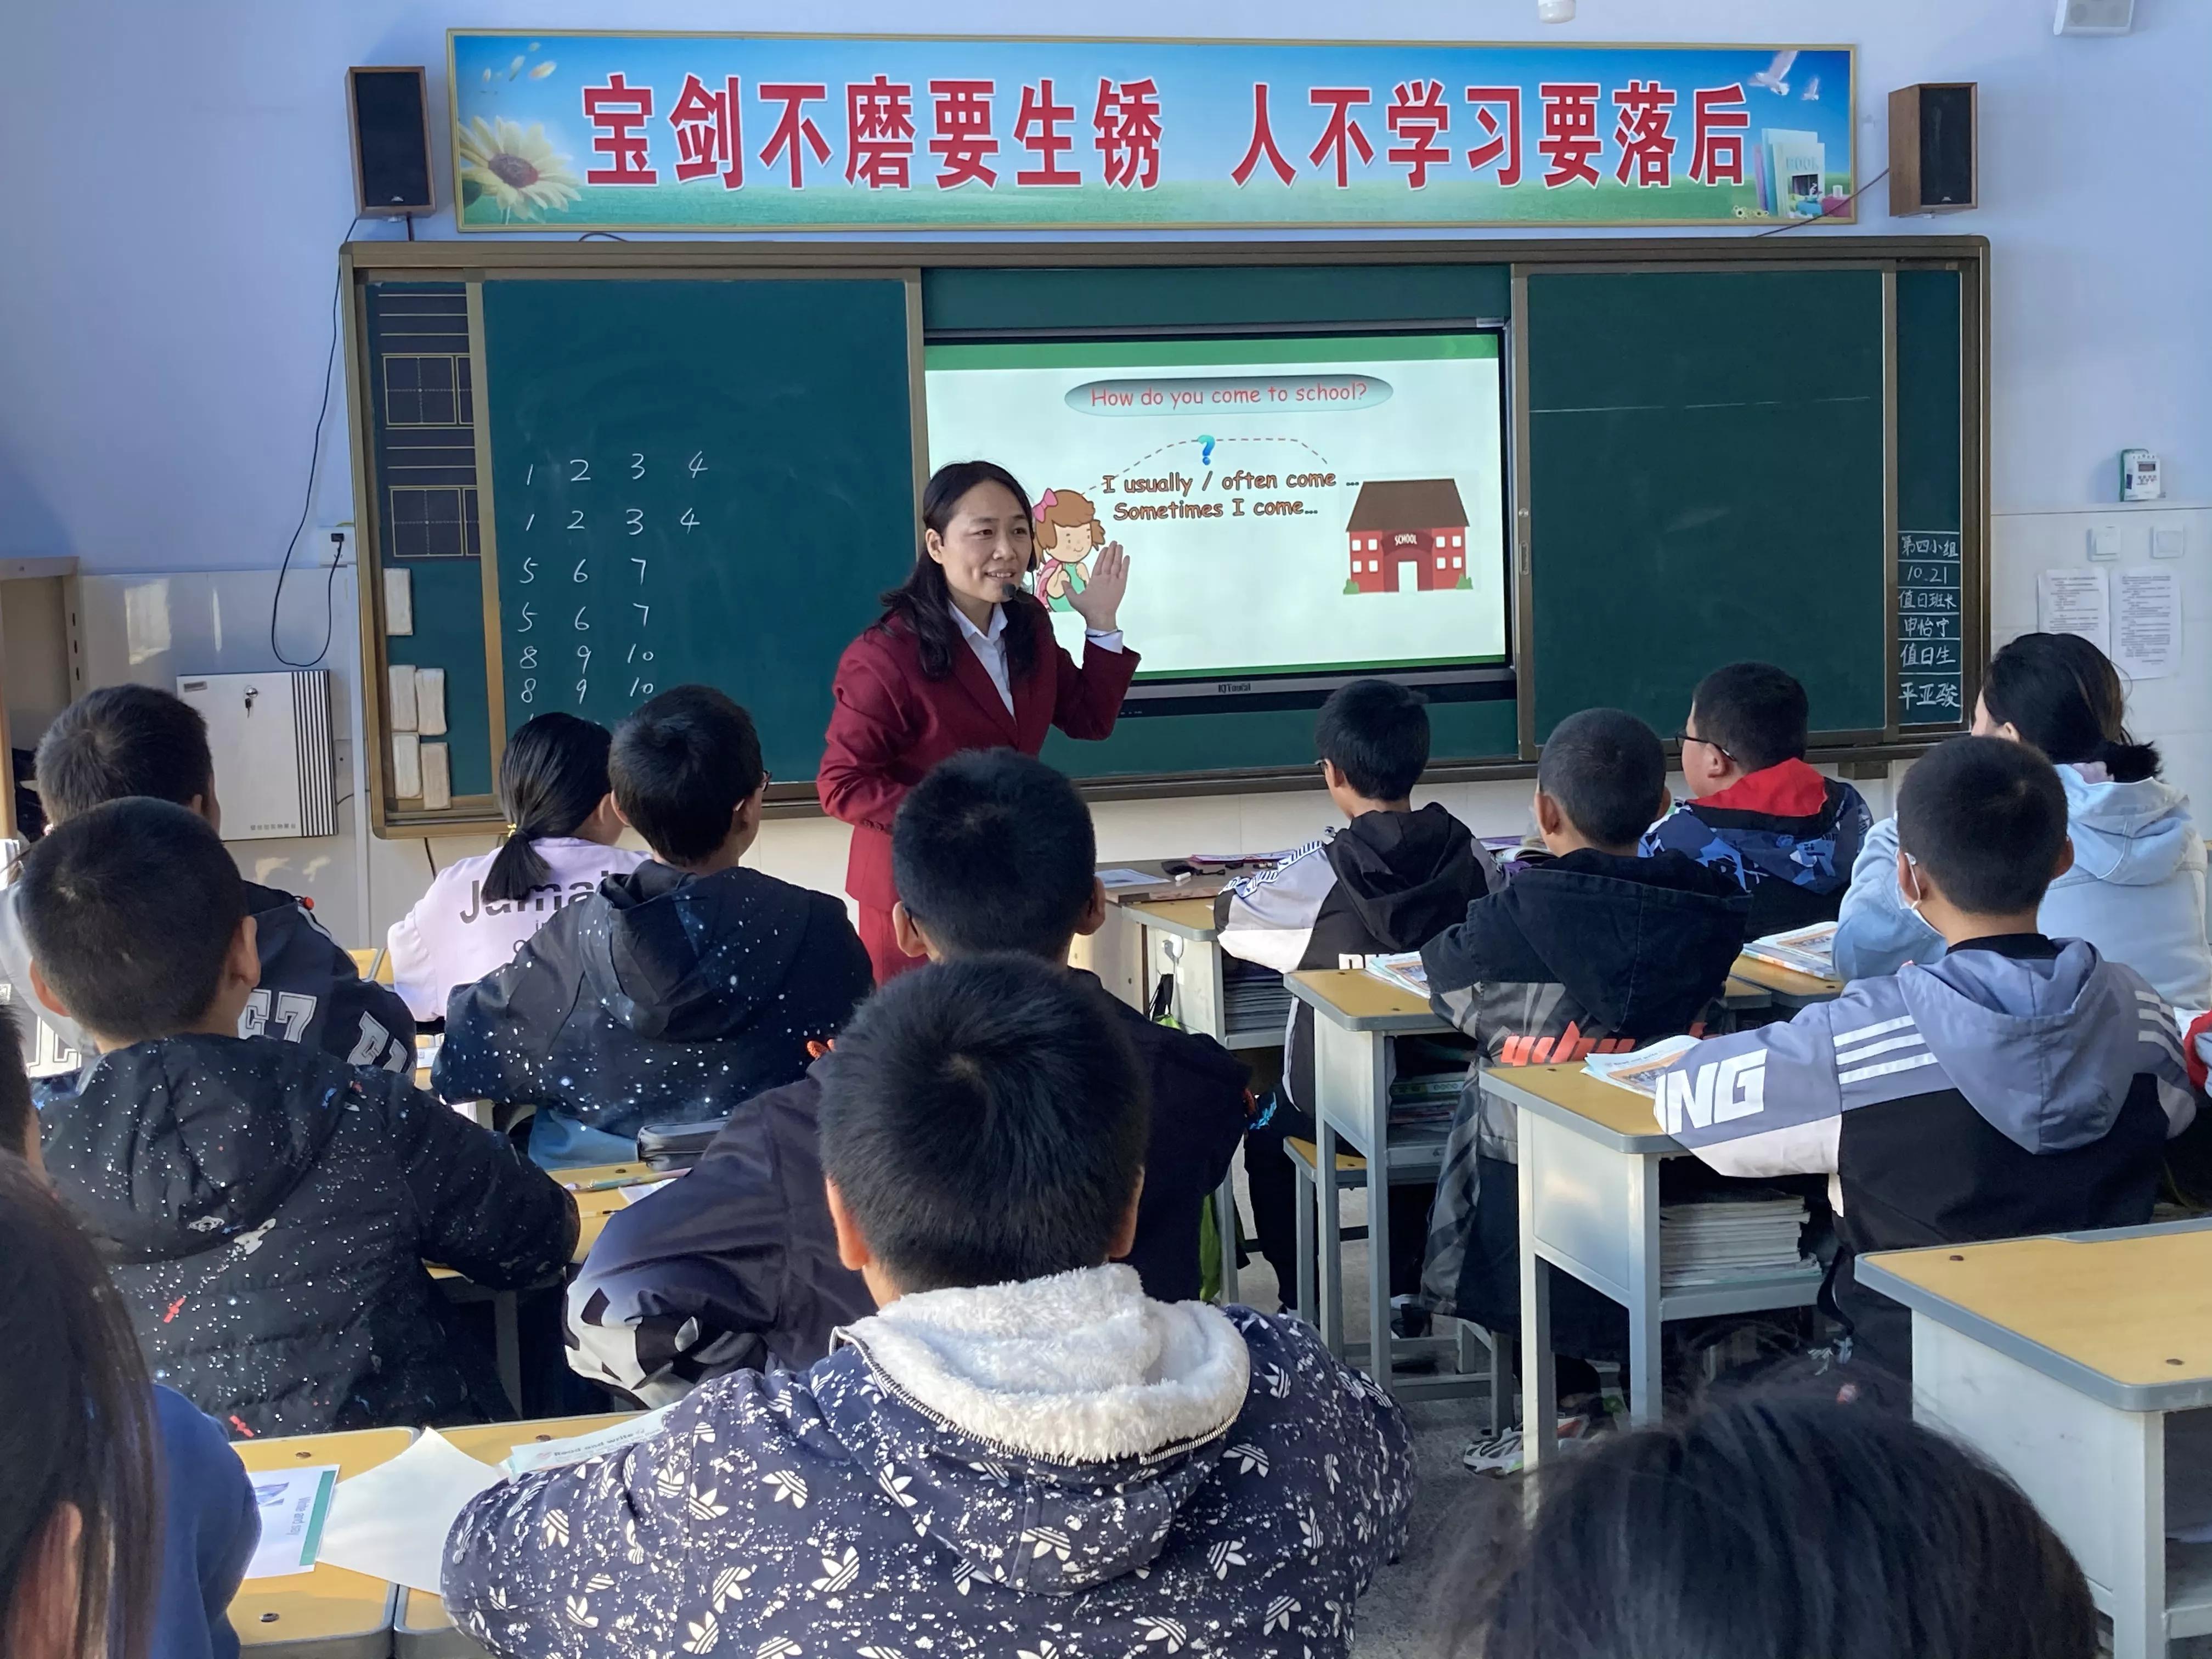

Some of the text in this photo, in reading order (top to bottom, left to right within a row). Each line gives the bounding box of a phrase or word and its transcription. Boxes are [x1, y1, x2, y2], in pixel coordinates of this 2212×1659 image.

[583, 72, 1750, 190] 宝剑不磨要生锈 人不学习要落后
[1091, 382, 1367, 410] How do you come to school?
[526, 450, 709, 486] 1 2 3 4
[1103, 476, 1116, 494] I
[1124, 472, 1193, 496] usually
[1221, 470, 1278, 490] often
[1286, 471, 1337, 488] come
[526, 507, 701, 535] 1 2 3 4
[1113, 500, 1224, 521] Sometimes
[1232, 499, 1245, 517] I
[1394, 533, 1418, 546] SCHOOL
[1901, 535, 1959, 557] 第四小组
[519, 557, 647, 585] 5 6 7
[1907, 566, 1948, 584] 10.21
[1898, 589, 1957, 610] 值日班长
[517, 602, 650, 632] 5 6 7
[520, 644, 654, 674] 8 9 10
[1900, 642, 1956, 668] 值日生
[521, 676, 654, 705] 8 9 10
